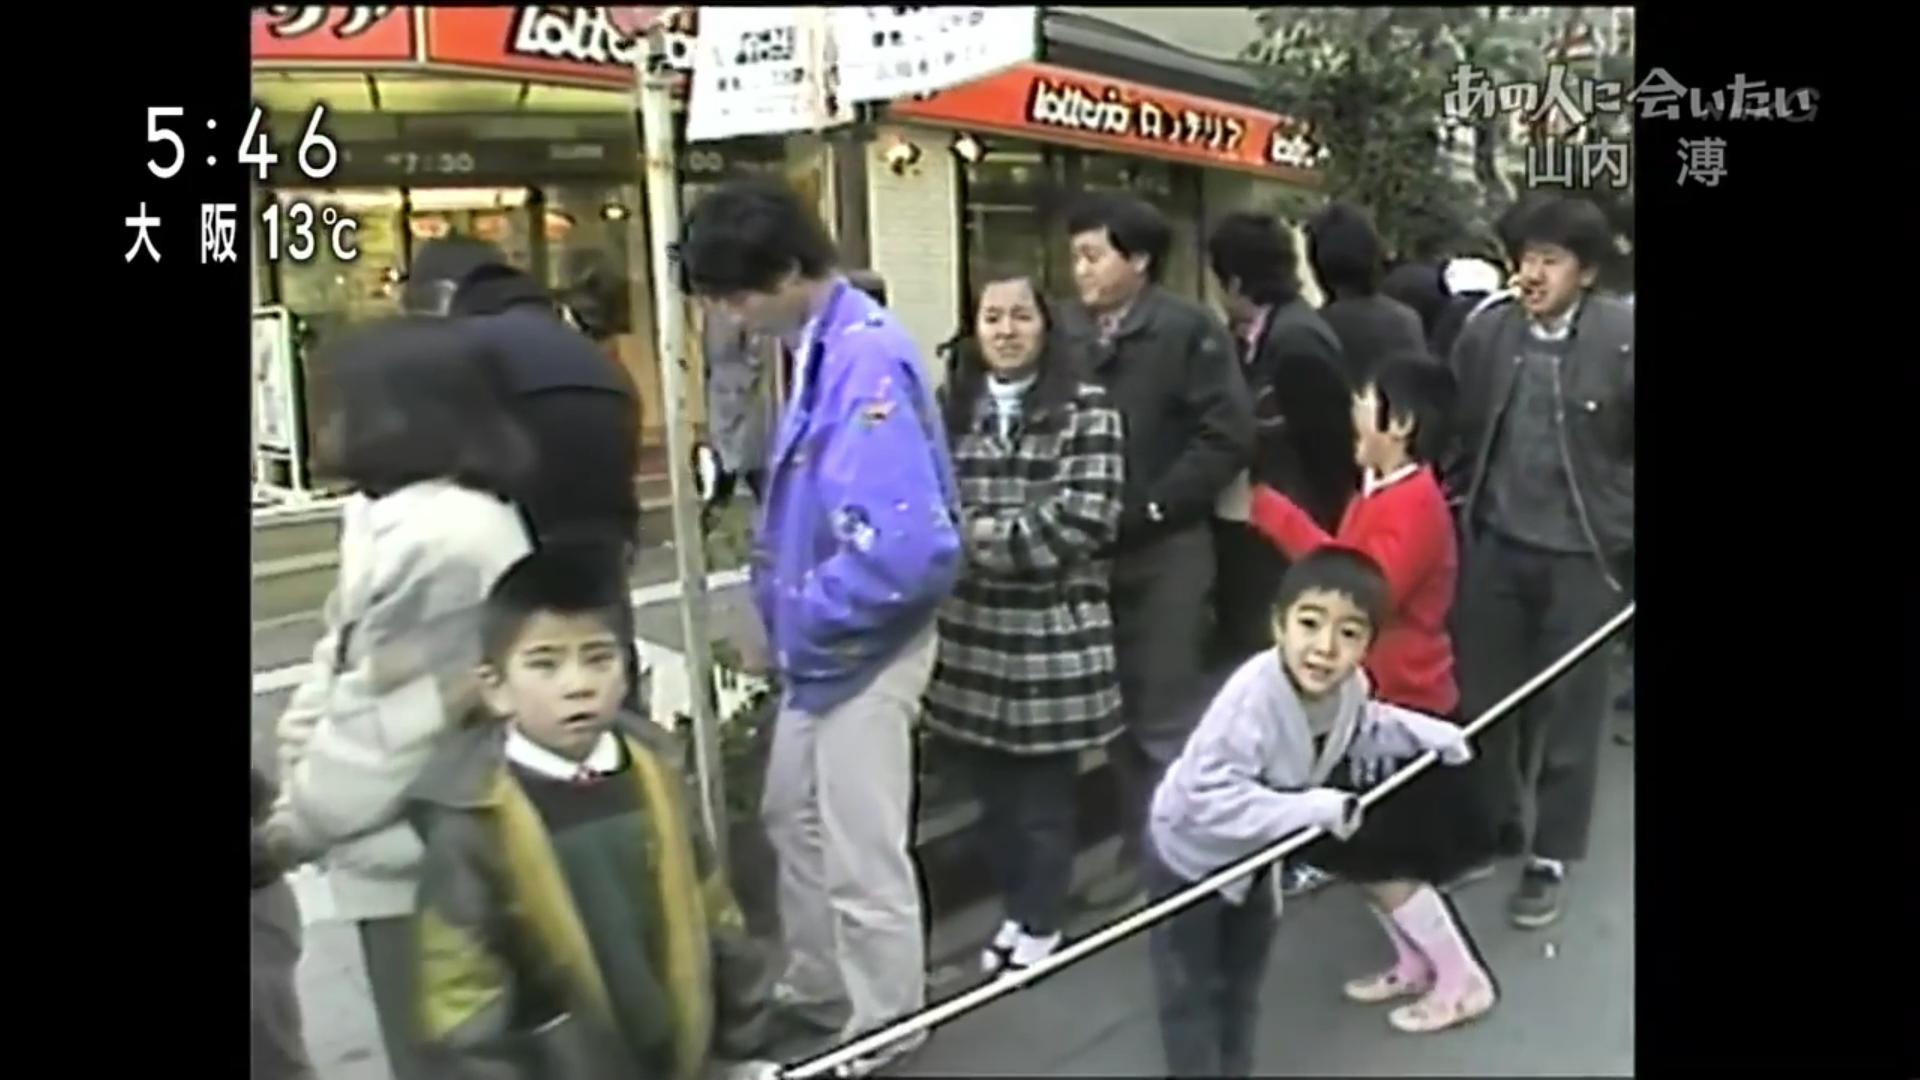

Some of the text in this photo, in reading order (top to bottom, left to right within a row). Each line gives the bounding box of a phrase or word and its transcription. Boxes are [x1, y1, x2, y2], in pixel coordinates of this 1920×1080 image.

[1141, 102, 1243, 149] ロッテリア
